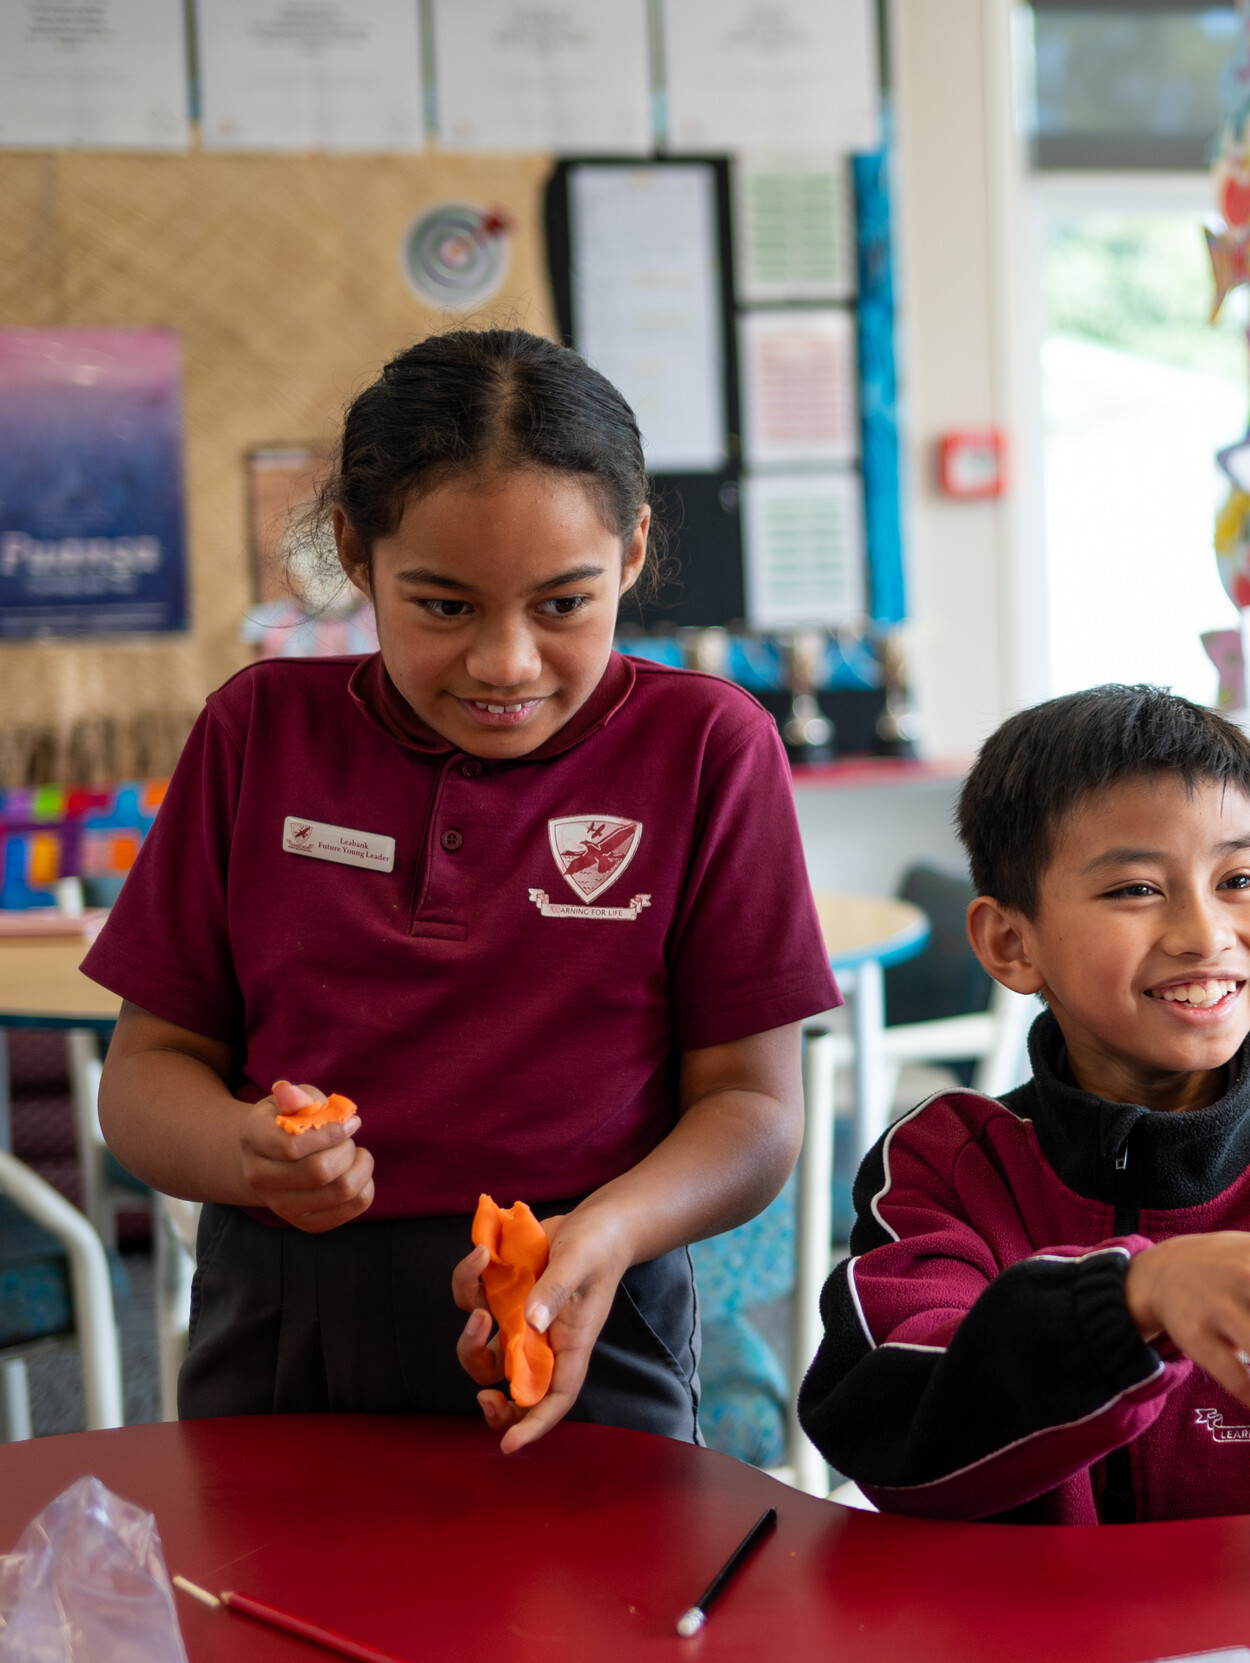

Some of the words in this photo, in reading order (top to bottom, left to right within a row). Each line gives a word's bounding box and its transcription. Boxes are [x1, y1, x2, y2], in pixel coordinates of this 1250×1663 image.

[340, 838, 368, 849] Leabank
[318, 842, 341, 852] Future
[343, 846, 365, 858] Young
[366, 852, 390, 861] Leader
[591, 908, 606, 916] FOR
